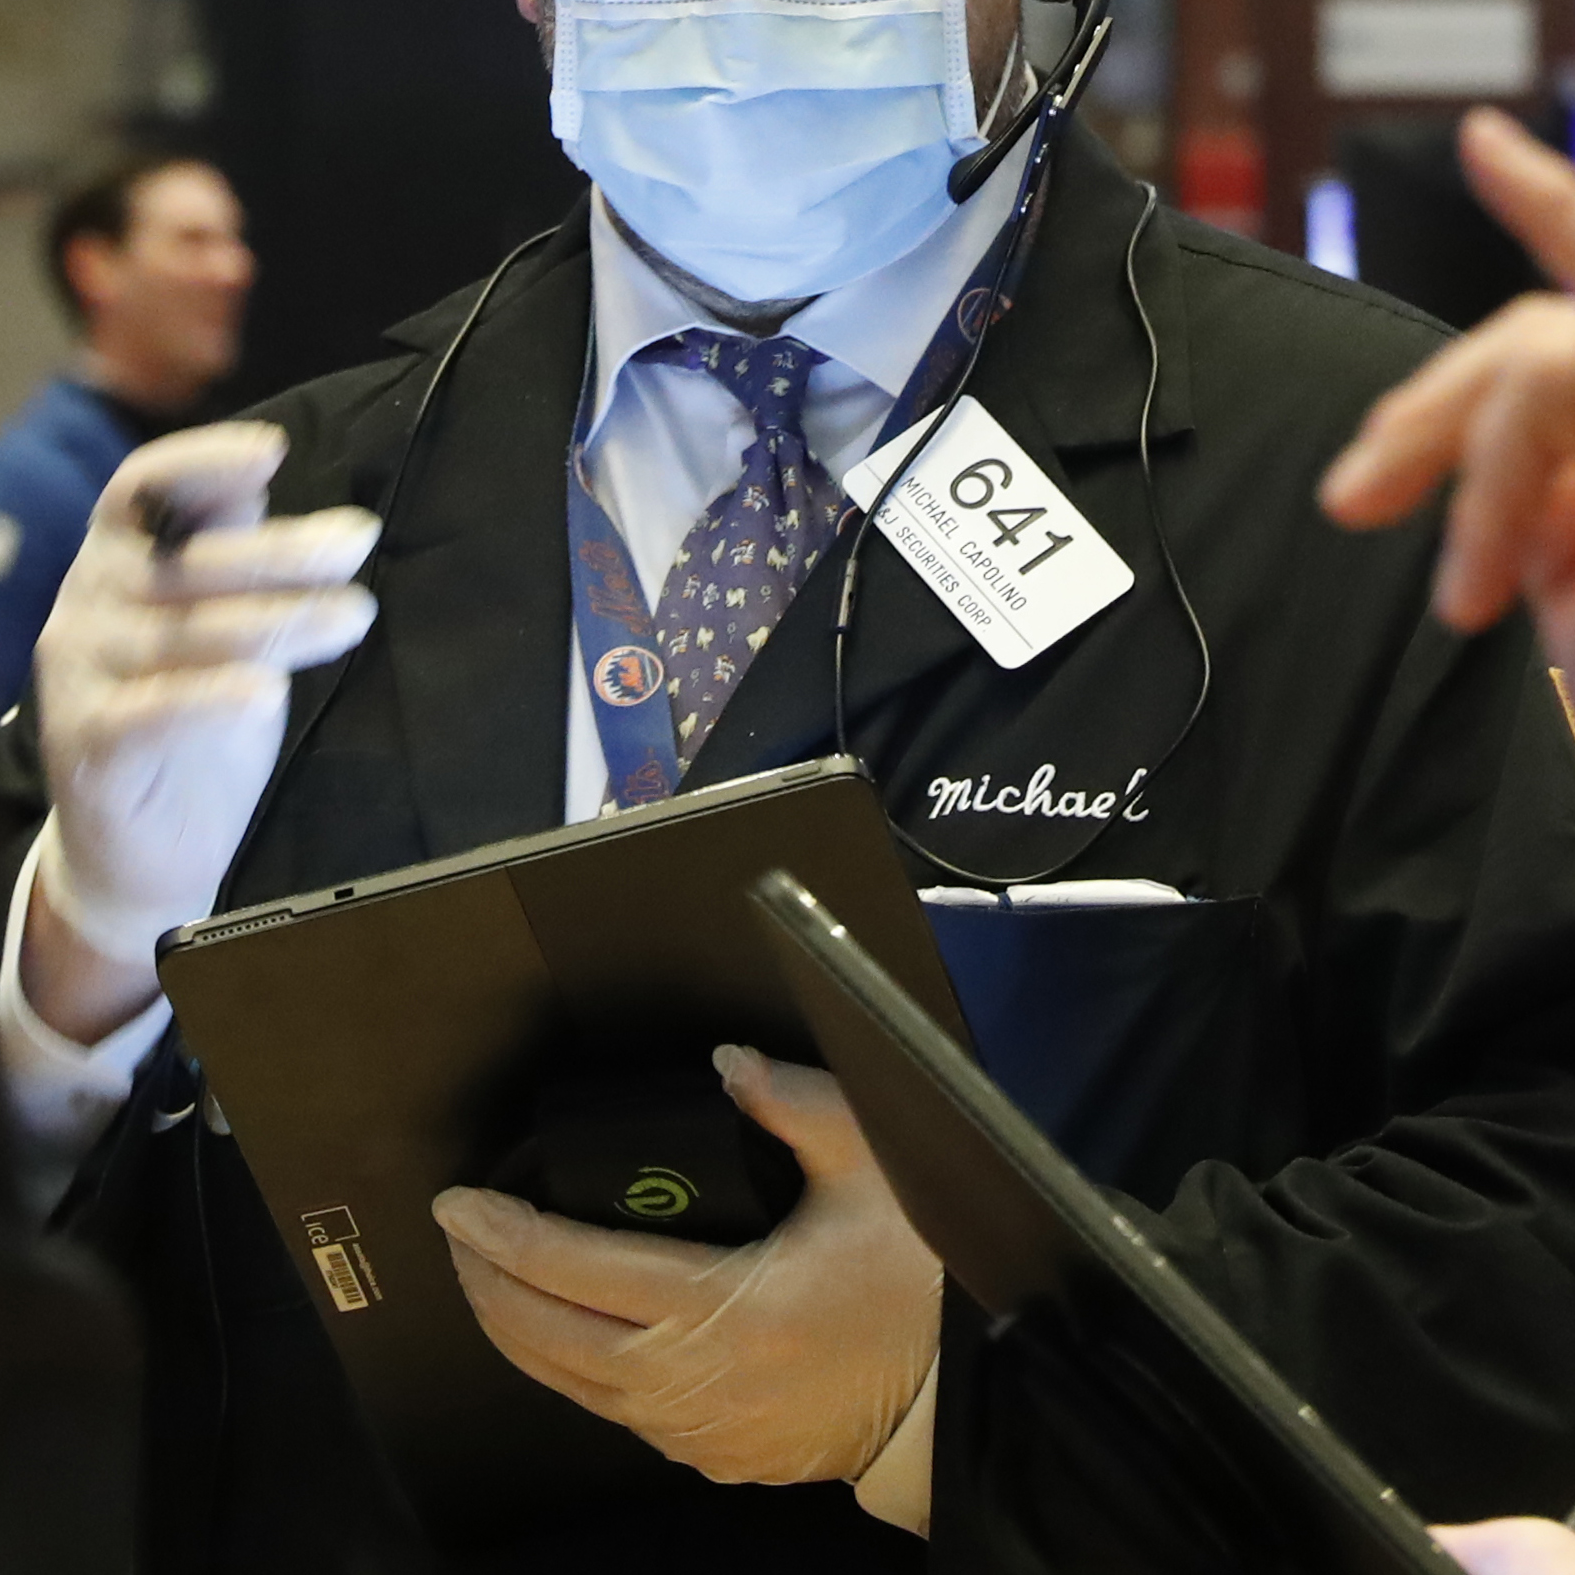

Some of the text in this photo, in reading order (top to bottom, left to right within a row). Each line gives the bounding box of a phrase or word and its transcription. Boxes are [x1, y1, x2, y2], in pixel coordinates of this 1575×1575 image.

[901, 477, 1027, 612] MICHAEL CAPOLINO
[948, 458, 1074, 576] 641
[896, 526, 960, 593] SECURITIES
[957, 594, 992, 633] CORP.
[927, 763, 1149, 823] Michael
